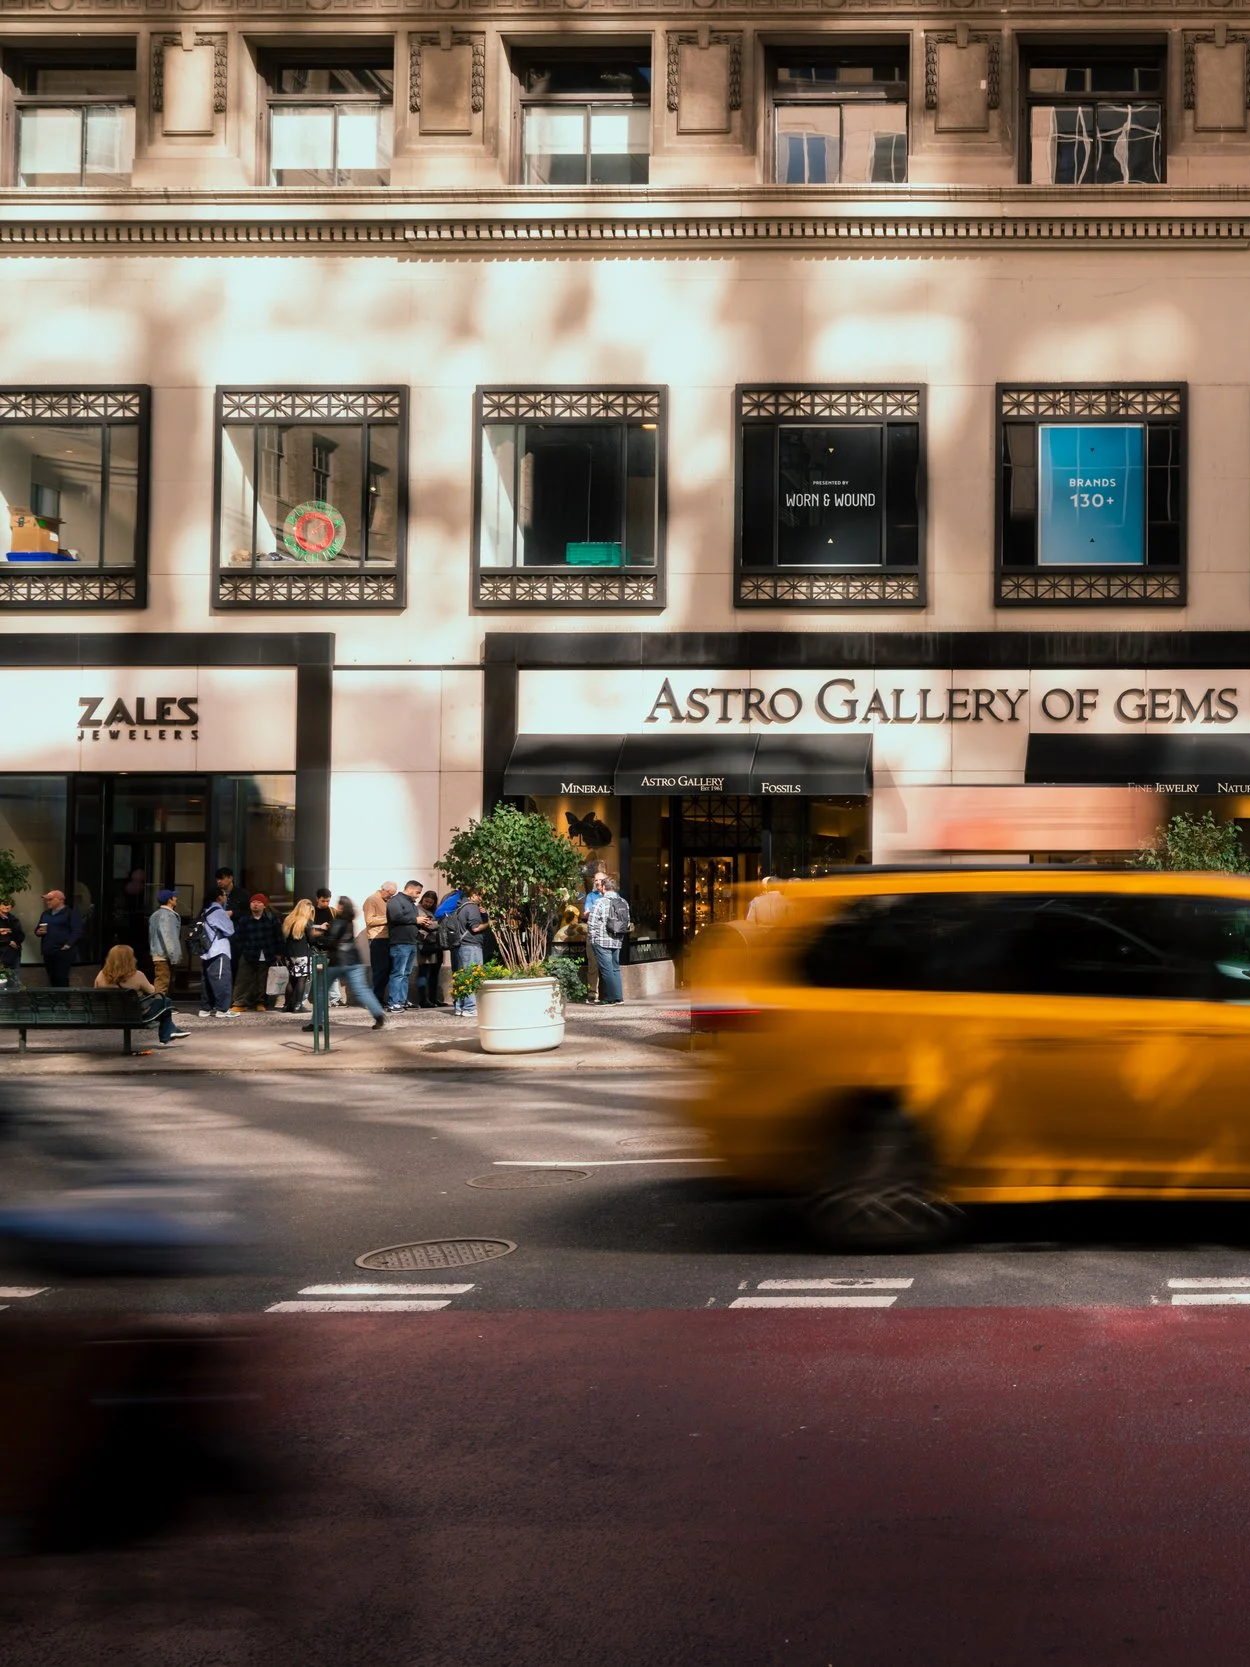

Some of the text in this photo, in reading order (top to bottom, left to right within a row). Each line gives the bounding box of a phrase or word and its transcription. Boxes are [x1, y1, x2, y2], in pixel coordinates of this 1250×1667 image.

[1069, 478, 1117, 487] BRANDS
[785, 493, 876, 507] WORN & WOUND
[1070, 493, 1115, 508] 130+
[645, 677, 1240, 724] ASTRO GALLERY OF GEMS
[77, 697, 199, 728] ZALES
[77, 729, 199, 741] JEWELERS
[640, 775, 725, 787] ASTRO GALLERY
[761, 782, 801, 794] FOSSILS
[1154, 782, 1200, 793] JEWELRY
